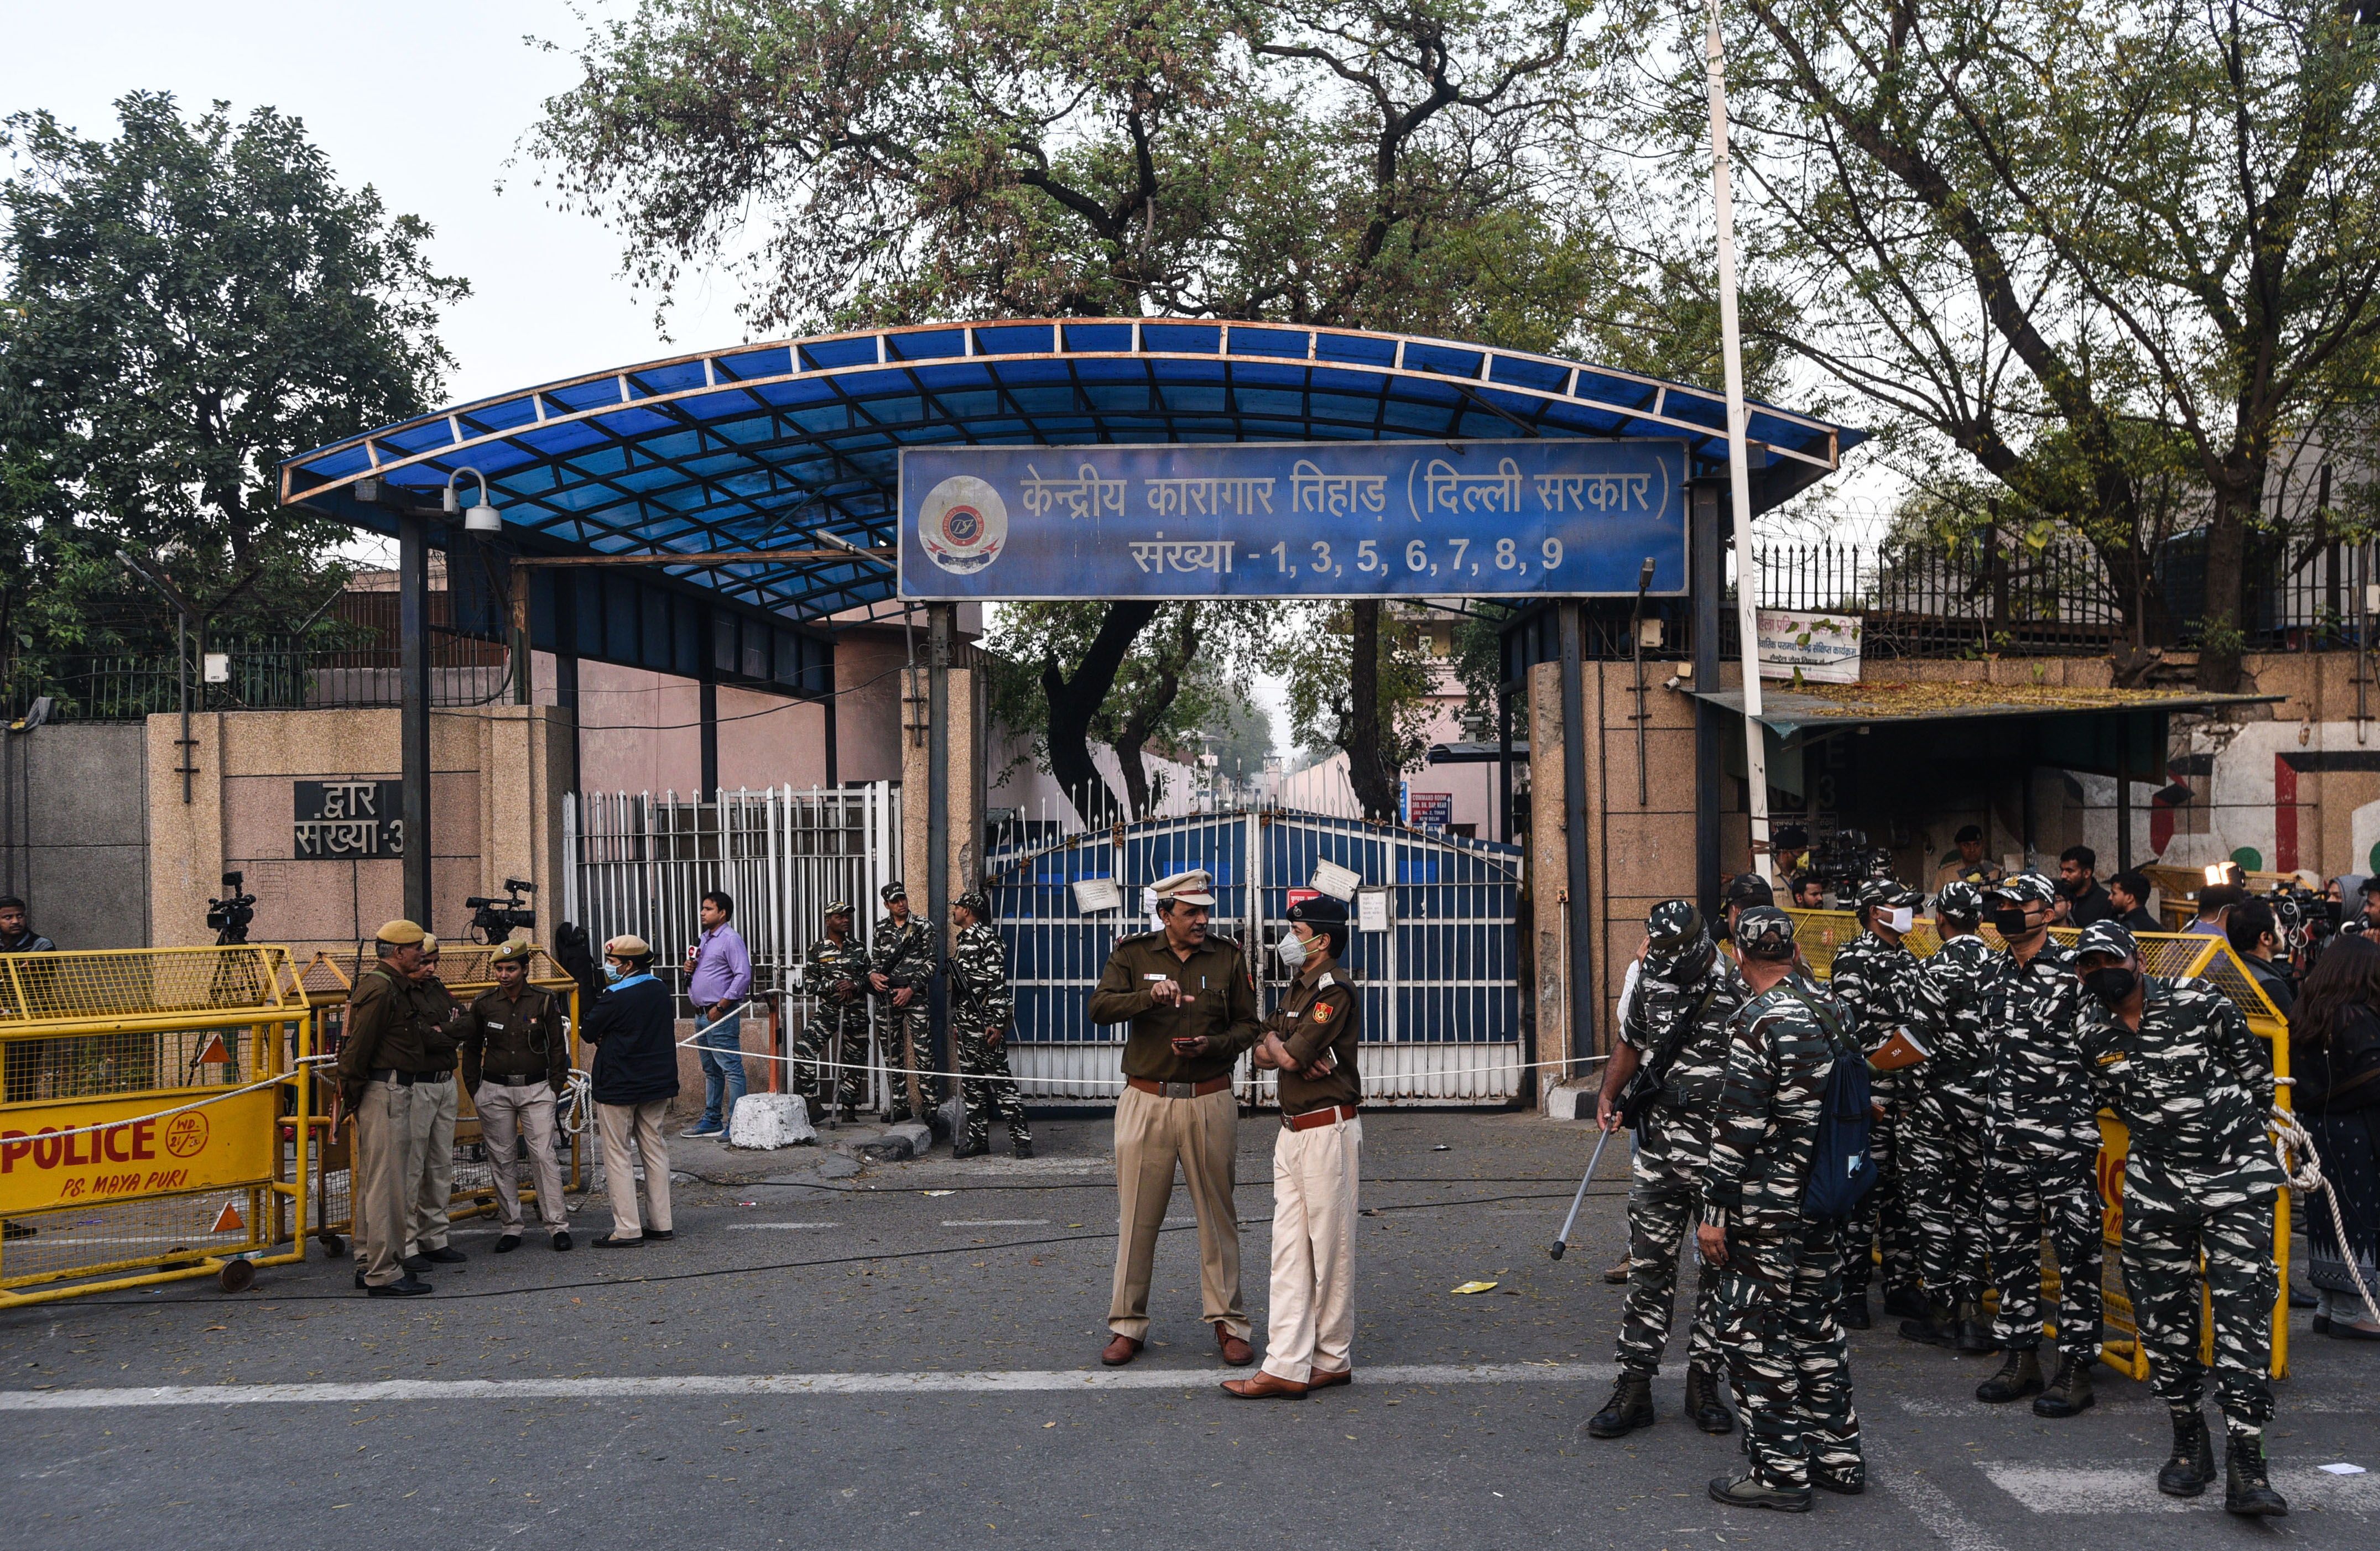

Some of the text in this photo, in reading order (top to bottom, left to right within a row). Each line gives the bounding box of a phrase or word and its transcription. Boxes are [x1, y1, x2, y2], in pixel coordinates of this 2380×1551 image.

[1020, 463, 1127, 519] केन्द्रीय
[1145, 478, 1275, 515] कारागार
[1289, 459, 1388, 522] तिहाड़
[1128, 531, 1235, 573] संख्या
[1311, 540, 1342, 578] 3,
[1357, 540, 1389, 577] 5,
[1405, 540, 1437, 577] 6,
[1449, 538, 1478, 577] 7,
[1496, 537, 1527, 576] 8,
[1541, 537, 1564, 570] 9
[1758, 614, 1774, 631] हिला
[322, 782, 377, 818] द्वार
[1, 1117, 156, 1173] POLICE
[92, 1172, 140, 1195] MAYA
[145, 1169, 189, 1190] PURI
